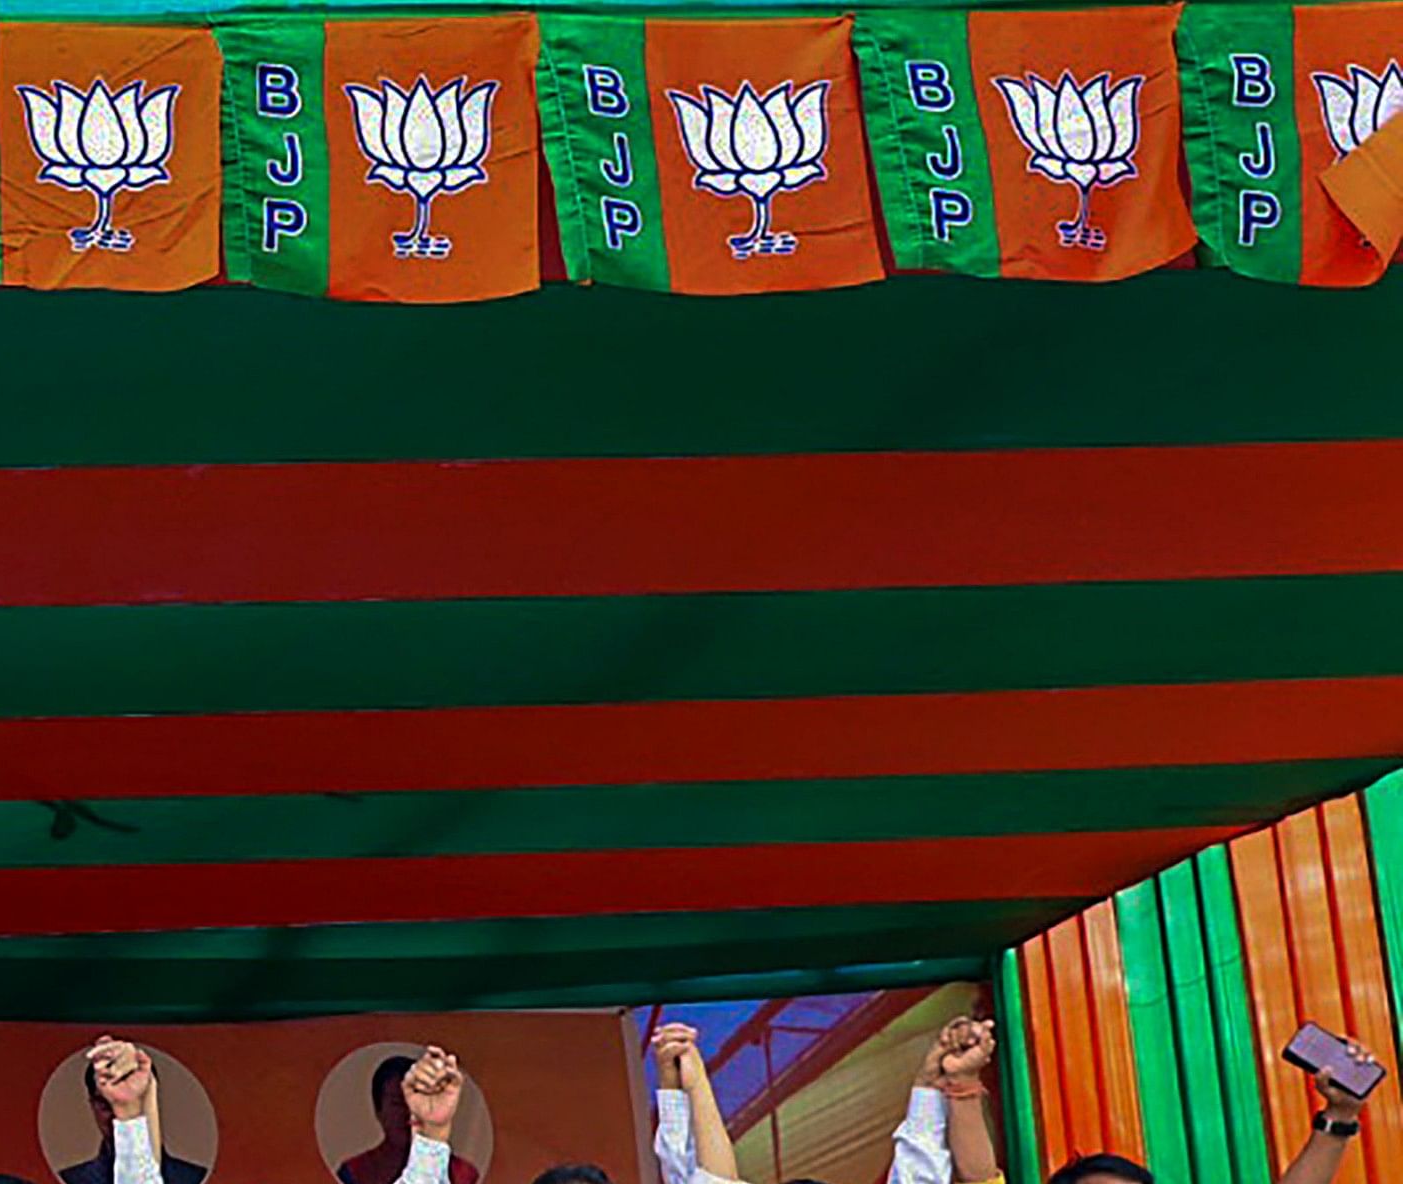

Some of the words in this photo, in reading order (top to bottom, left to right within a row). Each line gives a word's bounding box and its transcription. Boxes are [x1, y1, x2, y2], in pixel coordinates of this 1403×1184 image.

[255, 65, 305, 250] BJP
[584, 66, 642, 249] BJP
[906, 60, 972, 239] BJP
[1231, 54, 1280, 244] BJP
